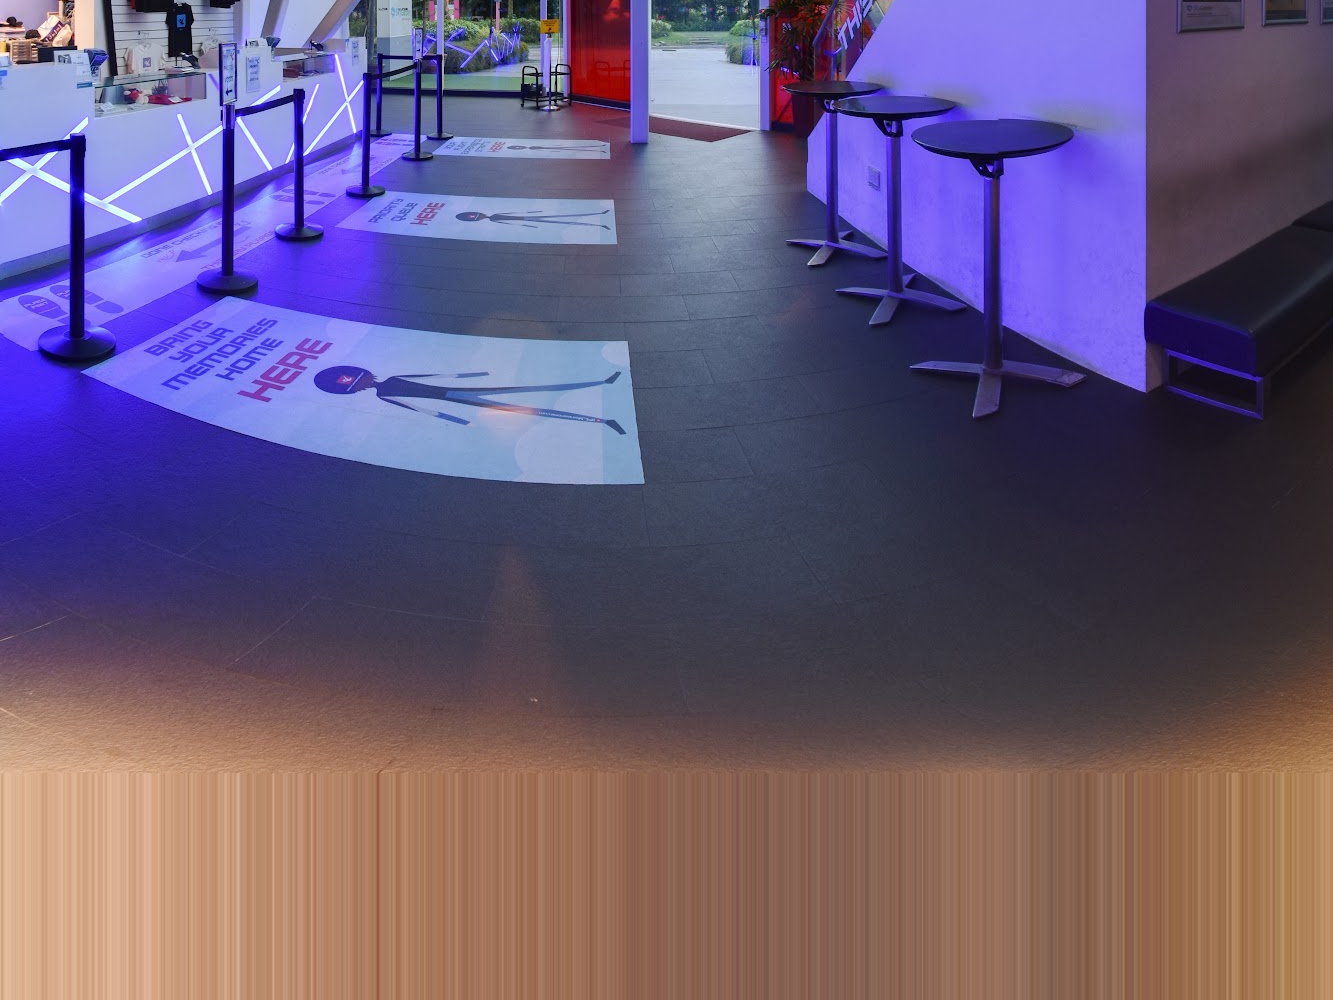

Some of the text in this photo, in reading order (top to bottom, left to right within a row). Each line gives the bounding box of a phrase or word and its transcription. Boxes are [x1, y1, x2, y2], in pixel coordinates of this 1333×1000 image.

[368, 198, 404, 223] PRIORITY
[410, 202, 446, 226] HERE
[143, 319, 214, 357] BRING
[161, 317, 279, 391] MEMORIES
[168, 327, 235, 363] YOUR
[214, 337, 284, 381] HOME
[237, 337, 334, 403] HERE
